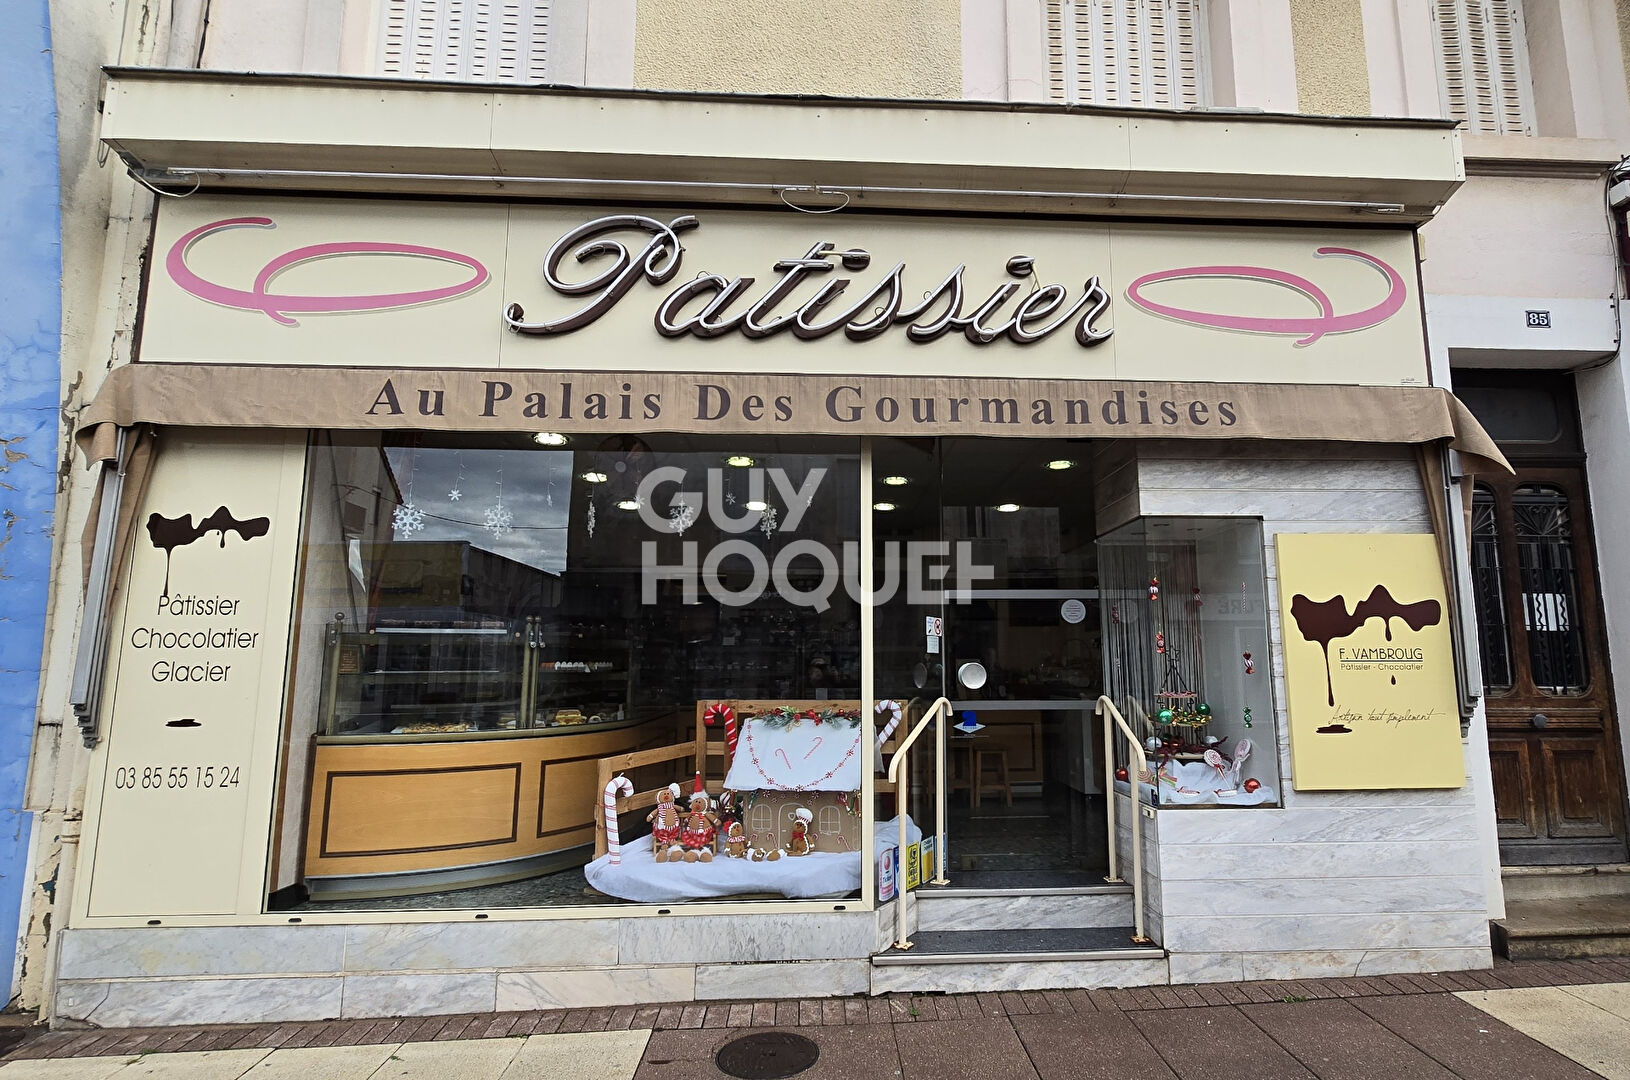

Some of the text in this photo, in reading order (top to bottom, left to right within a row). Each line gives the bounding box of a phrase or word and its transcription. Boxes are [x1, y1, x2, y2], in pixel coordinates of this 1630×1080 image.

[1529, 313, 1548, 325] 85
[365, 378, 1237, 427] Au Palais Des Gourmandises
[157, 593, 240, 616] Pâtissier
[131, 627, 259, 649] Chocolatier
[1339, 647, 1423, 660] F. VAMBROUG
[151, 660, 231, 682] Glacier
[1378, 662, 1424, 671] Chocolatier
[115, 766, 240, 789] 03 85 55 15 24
